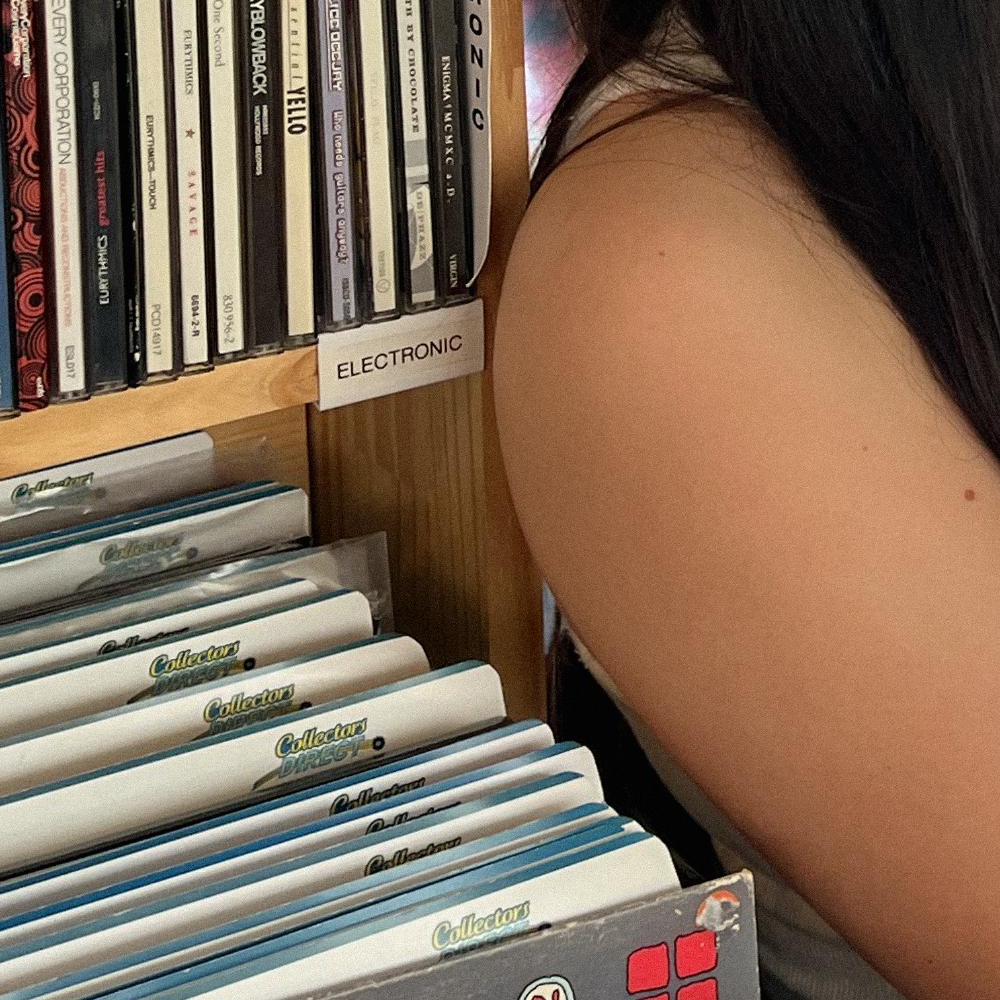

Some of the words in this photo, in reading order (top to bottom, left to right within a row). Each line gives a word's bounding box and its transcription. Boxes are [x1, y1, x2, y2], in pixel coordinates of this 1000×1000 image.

[213, 26, 226, 68] Second
[405, 24, 416, 43] BY
[183, 28, 195, 96] EURYTHMICS
[440, 55, 453, 101] ENIGMA
[53, 51, 74, 166] CORPORATION
[287, 85, 308, 136] YELLO
[406, 47, 420, 134] CHOCOLATE
[442, 110, 455, 166] MCMXC
[95, 150, 107, 174] hits
[96, 177, 111, 227] greatest
[187, 169, 199, 238] SAVAGE
[98, 234, 110, 305] EURYTHMICS
[448, 253, 458, 289] VIRGIN
[336, 335, 464, 380] ELECTRONIC
[149, 640, 241, 678] Collectors
[204, 684, 295, 723] Collectors
[274, 717, 368, 759] Collectors
[278, 735, 366, 780] DIRECT
[432, 899, 531, 952] Collectors
